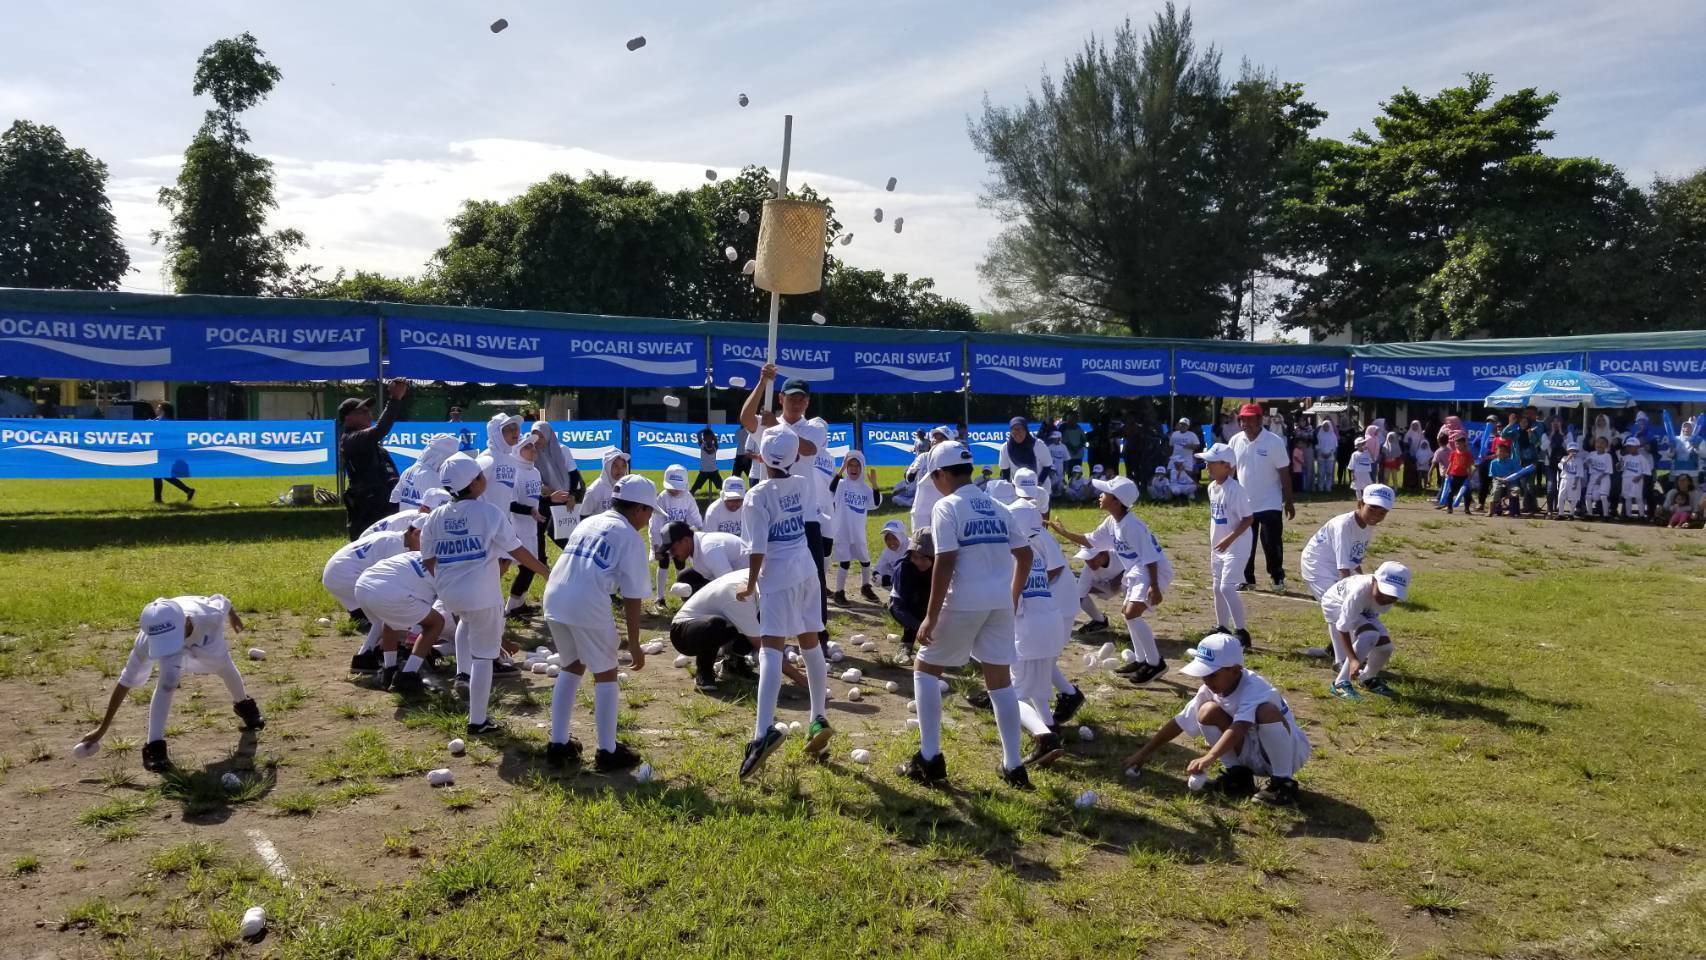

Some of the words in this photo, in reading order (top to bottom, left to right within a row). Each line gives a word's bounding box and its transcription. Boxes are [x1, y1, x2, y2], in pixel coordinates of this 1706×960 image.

[0, 318, 76, 338] OCARI
[83, 323, 166, 340] SWEAT
[206, 327, 286, 343] POCARI
[292, 328, 364, 344] SWEAT
[400, 329, 472, 348] POCARI
[476, 334, 540, 352] SWEAT
[570, 339, 634, 354] POCARI
[638, 341, 694, 355] SWEAT
[722, 344, 777, 360] POCAR
[782, 348, 831, 362] SWEAT
[854, 351, 904, 365] POCARI
[908, 351, 951, 364] SWEAT
[976, 353, 1019, 367] POCARI
[1022, 356, 1064, 369] SWEAT
[1082, 358, 1122, 370] POCARI
[1124, 359, 1161, 371] SWEAT
[1180, 358, 1218, 373] POCARI
[1219, 362, 1255, 375] SWEAT
[1600, 360, 1658, 372] POCARI
[1662, 360, 1706, 372] SWEA
[1270, 364, 1304, 376] POCARI
[1305, 362, 1339, 376] SWEAT
[1362, 363, 1406, 376] POCARI
[1408, 365, 1451, 376] SWEAT
[1472, 364, 1521, 376] POCARI
[2, 429, 78, 444] POCARI
[84, 432, 154, 445] SWEAT
[187, 432, 256, 445] POCARI
[261, 431, 324, 444] SWEAT
[562, 430, 612, 442] SWEAT
[638, 431, 687, 443] POCARI
[691, 433, 736, 444] SAT
[826, 432, 847, 442] EAT
[868, 431, 909, 441] POCARI
